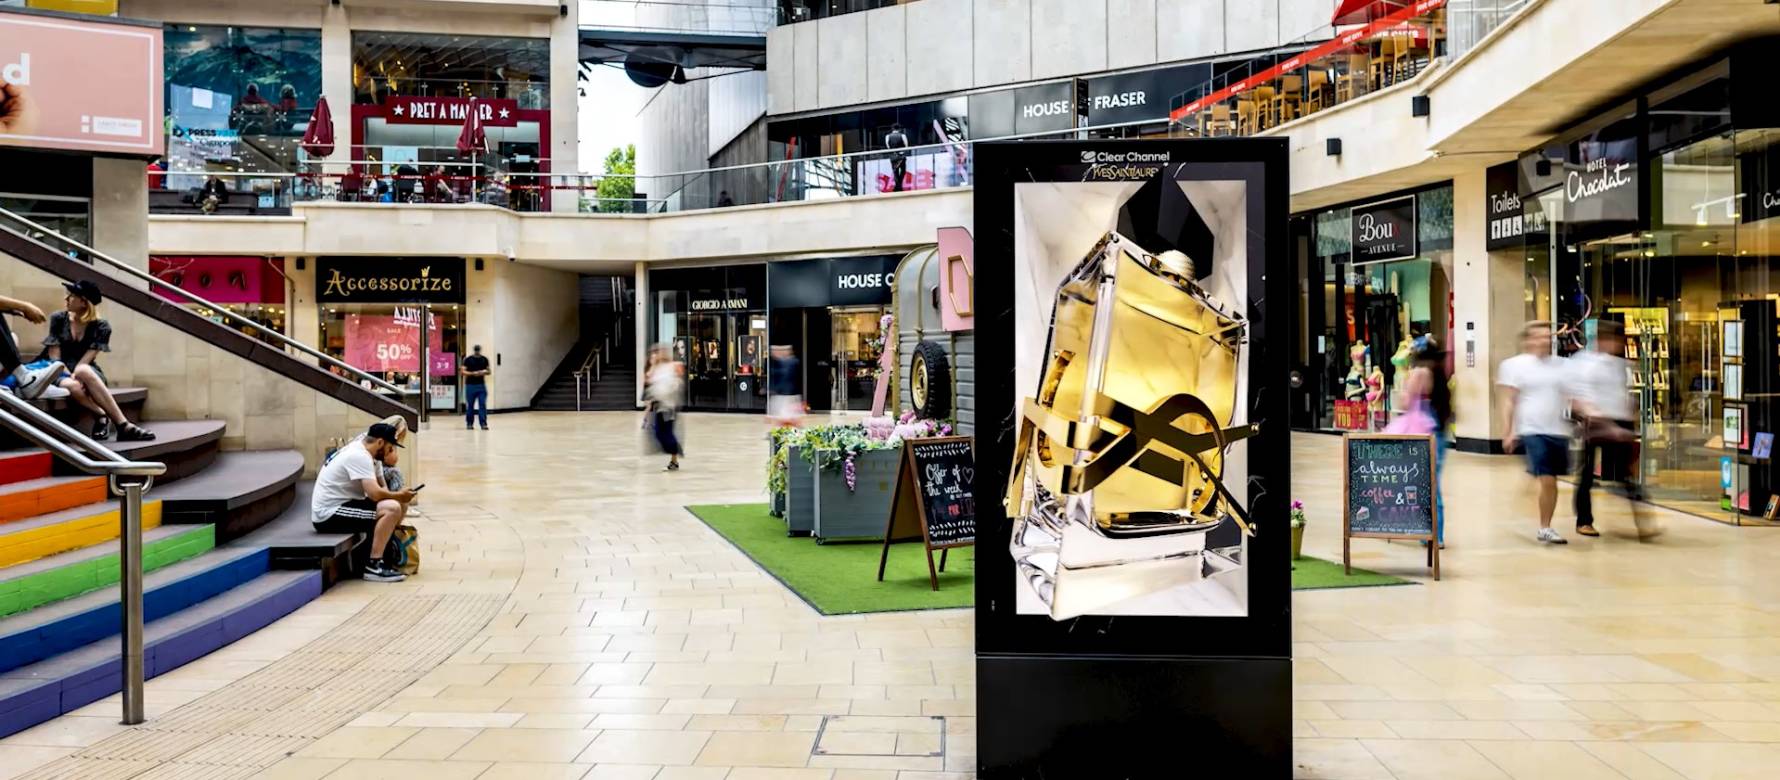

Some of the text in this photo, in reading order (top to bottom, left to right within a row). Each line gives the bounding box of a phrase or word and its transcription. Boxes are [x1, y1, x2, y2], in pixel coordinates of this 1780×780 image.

[410, 102, 493, 120] PRET A MAER
[1023, 100, 1069, 118] HOUSE
[1094, 91, 1146, 110] FRASER
[1097, 151, 1170, 162] Clear Channel
[1586, 157, 1607, 173] HOTEL
[1491, 188, 1521, 214] Toilets
[1368, 242, 1397, 255] AVENUE
[323, 266, 452, 297] Accessorize
[838, 273, 882, 289] HOUSE
[692, 299, 748, 310] GIORGIO ARMANI
[925, 463, 961, 485] Offer of
[1353, 460, 1419, 483] always
[1361, 475, 1398, 483] TIME
[924, 480, 941, 497] the
[944, 480, 963, 494] week
[1361, 487, 1405, 505] coffee &
